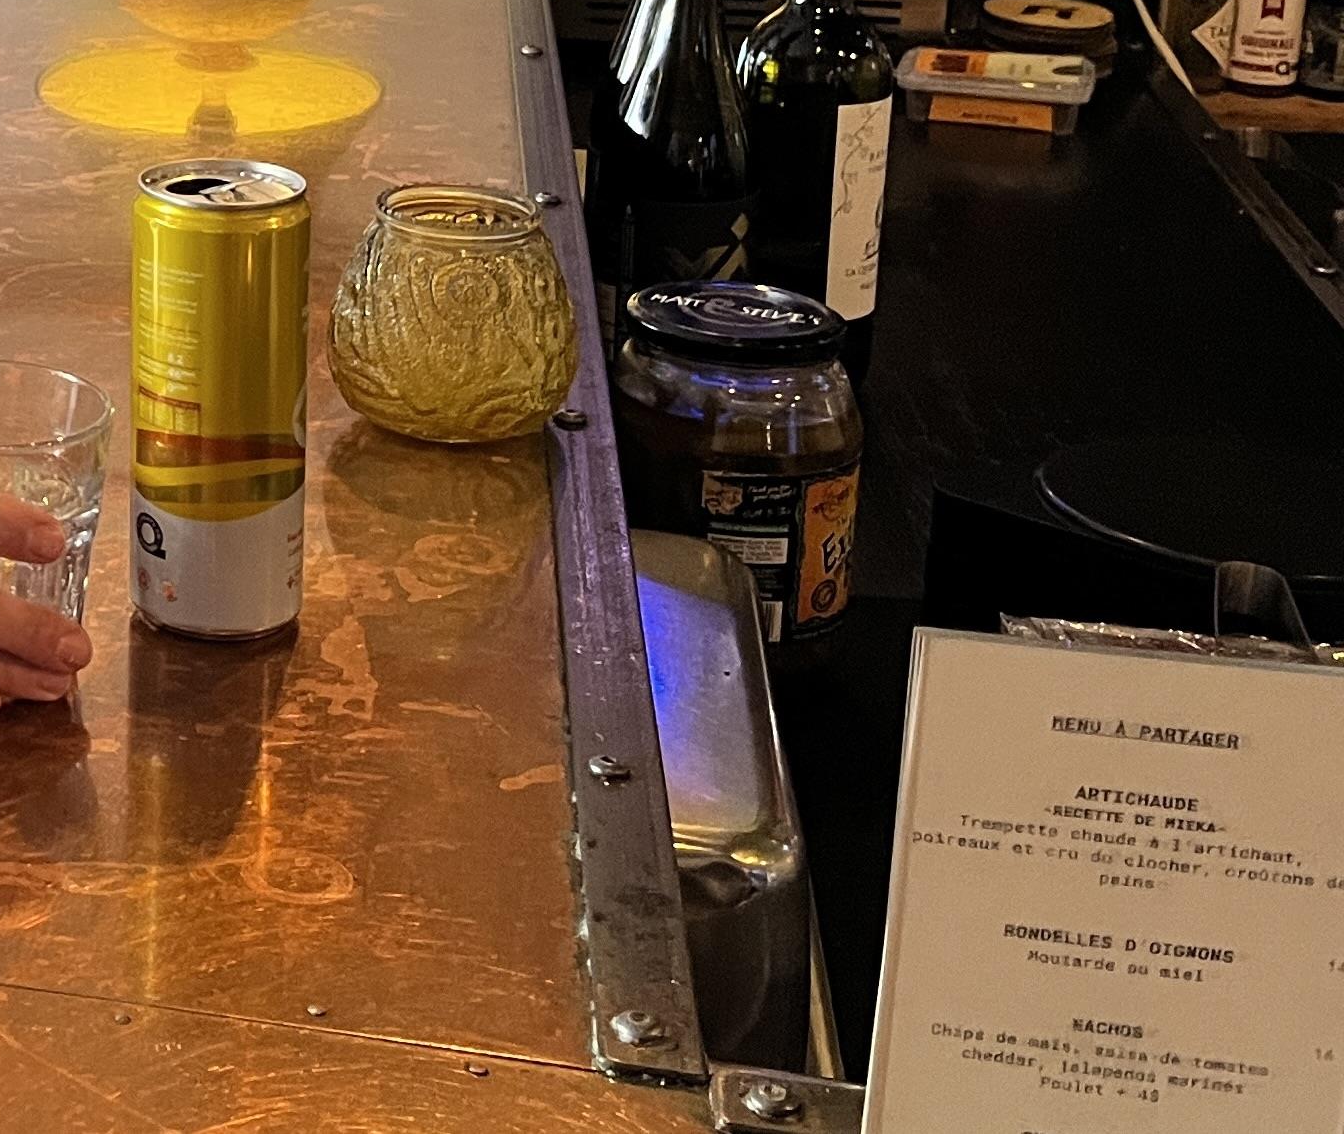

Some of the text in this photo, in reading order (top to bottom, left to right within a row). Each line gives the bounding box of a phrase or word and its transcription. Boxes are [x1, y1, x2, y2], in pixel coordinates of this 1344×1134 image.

[649, 292, 706, 308] MATT
[1050, 715, 1102, 734] MENU
[1139, 724, 1240, 750] PARTAGER
[1074, 785, 1200, 812] ARTICHAUDE
[960, 814, 1059, 839] Trempette
[1070, 828, 1137, 846] chaude
[1134, 814, 1155, 827] DE
[912, 830, 1000, 851] poireaux
[1011, 842, 1034, 856] et
[1045, 847, 1079, 861] cru
[1124, 854, 1210, 878] clocher,
[1002, 923, 1235, 964] RONDELLES D'OIGNONS
[1027, 949, 1116, 973] Moutarde
[1159, 967, 1205, 982] miel
[1072, 1017, 1144, 1039] NACHOS
[930, 1022, 985, 1041] Chips
[995, 1030, 1018, 1045] de
[1192, 1056, 1270, 1076] tomates
[961, 1046, 1043, 1072] cheddar,
[1039, 1075, 1103, 1096] Poulet
